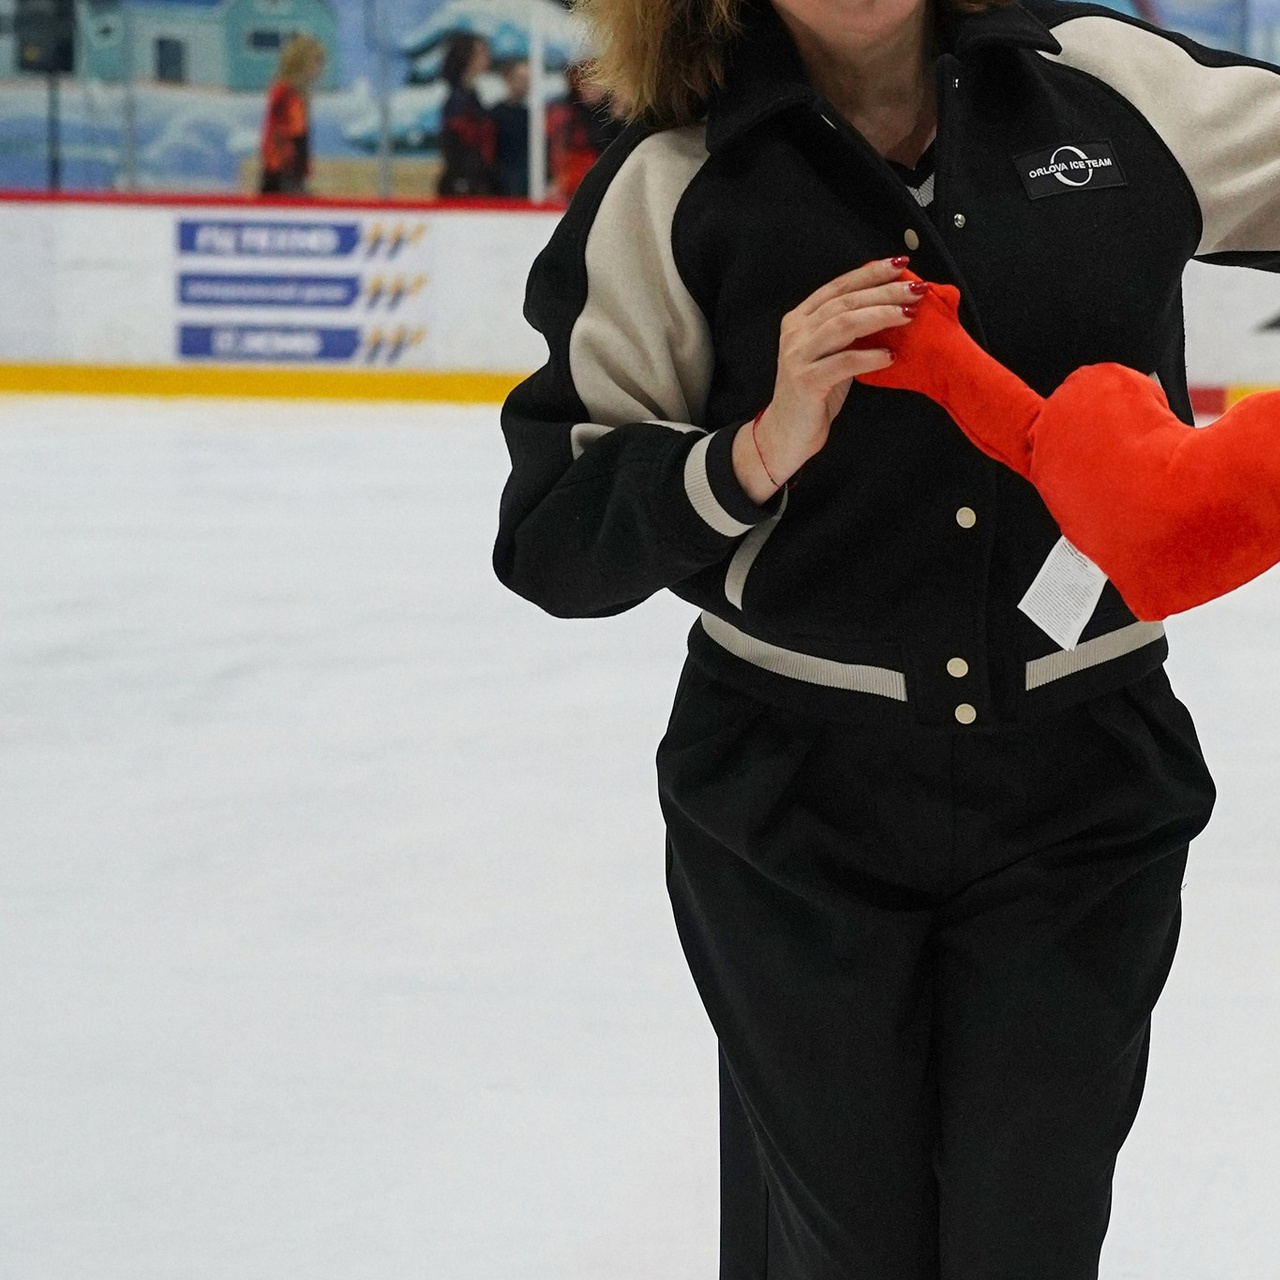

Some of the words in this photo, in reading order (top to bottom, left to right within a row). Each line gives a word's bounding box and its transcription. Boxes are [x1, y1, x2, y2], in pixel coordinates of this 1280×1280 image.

[1029, 163, 1069, 179] ORLOVA
[1070, 161, 1086, 170] ICE
[1086, 158, 1112, 168] TEAM
